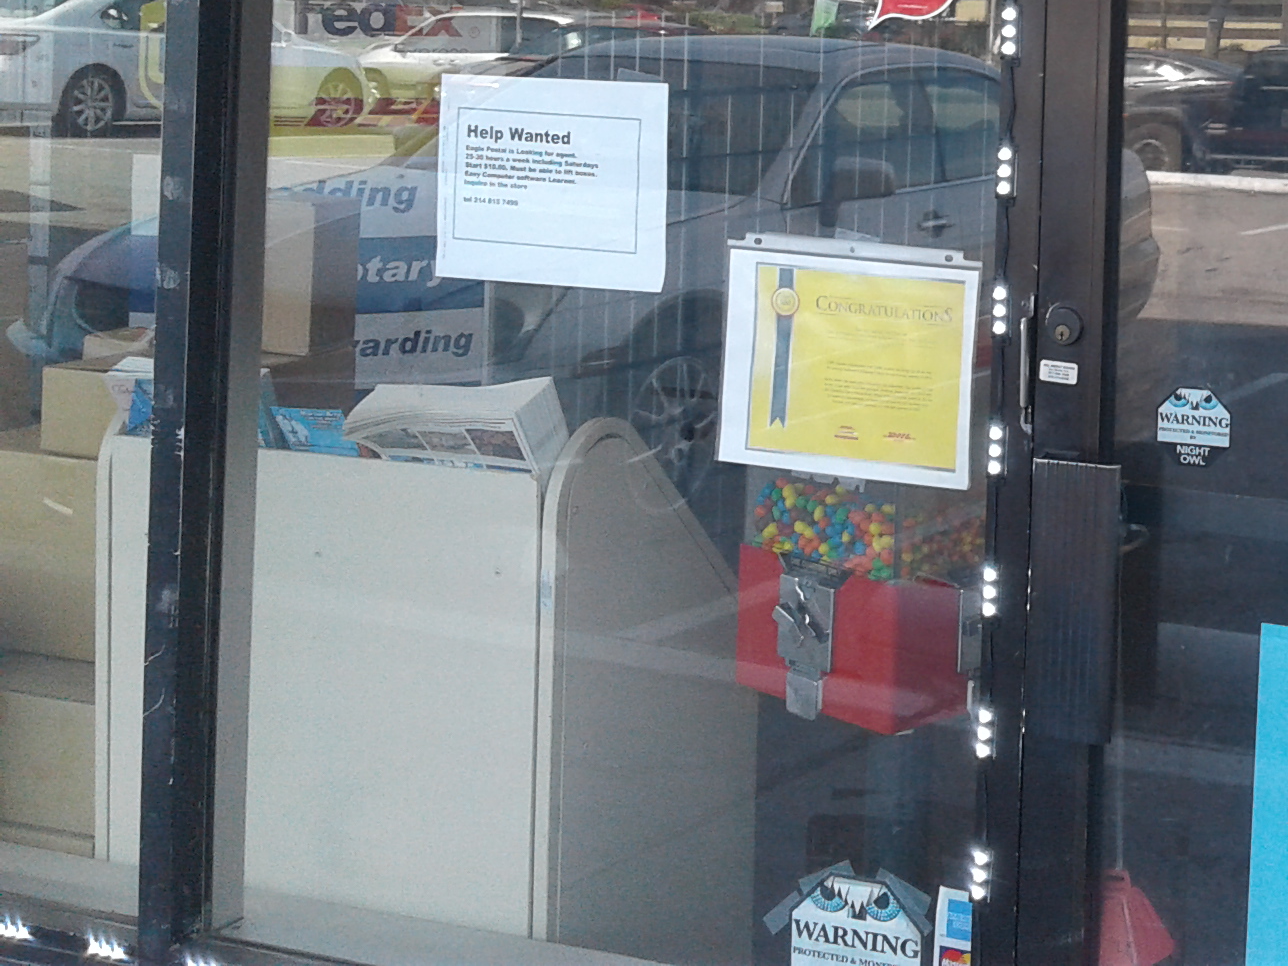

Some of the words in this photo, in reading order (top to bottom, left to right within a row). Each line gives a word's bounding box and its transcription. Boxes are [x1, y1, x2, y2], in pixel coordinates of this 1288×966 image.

[467, 124, 504, 143] Help
[509, 127, 572, 145] Wanted
[1159, 411, 1231, 429] WARNING
[1176, 444, 1210, 457] NIGHT
[1180, 454, 1206, 466] OWL
[794, 918, 920, 960] WARNING
[793, 945, 848, 964] PROTECTED
[849, 957, 857, 965] &
